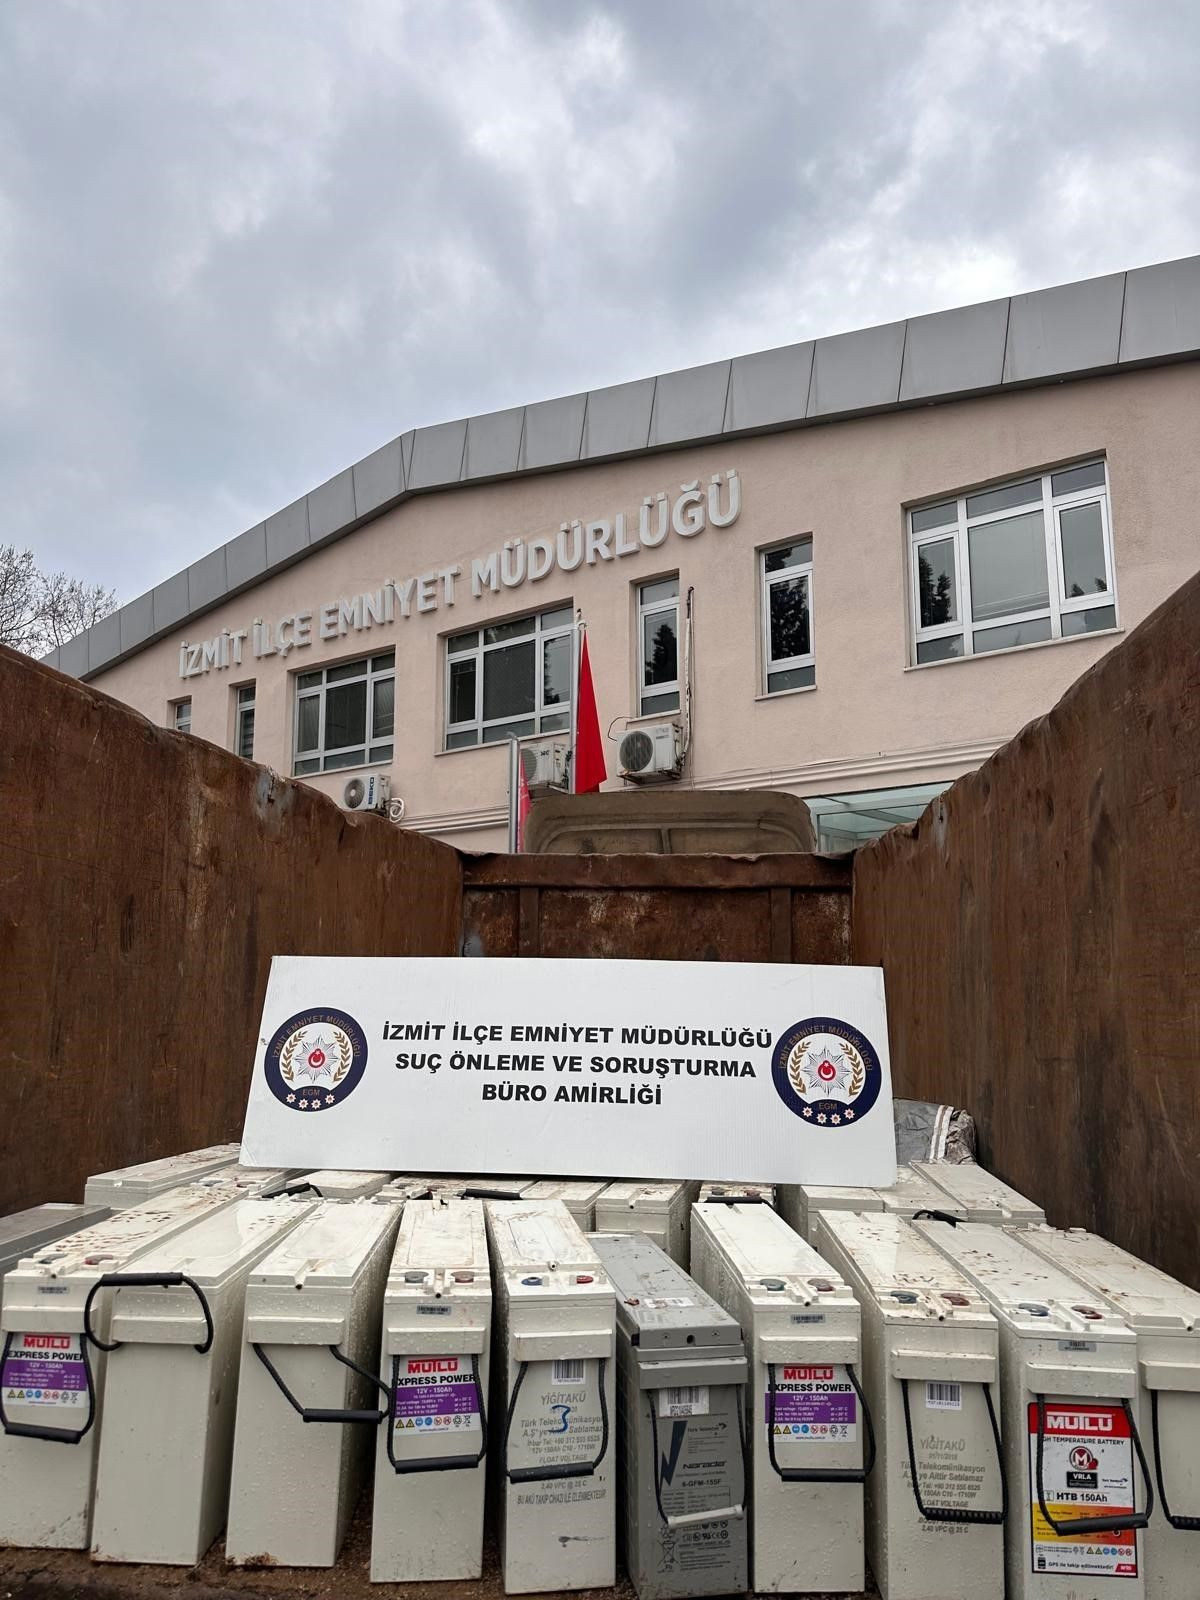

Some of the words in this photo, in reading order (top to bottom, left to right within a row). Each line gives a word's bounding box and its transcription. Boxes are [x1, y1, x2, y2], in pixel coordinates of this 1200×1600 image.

[180, 628, 246, 679] İZMİT
[252, 609, 312, 657] İLÇE
[320, 565, 462, 640] EMNİYET
[471, 469, 742, 598] MÜDÜRLÜĞÜ
[382, 1021, 446, 1040] İZMİT
[452, 1021, 503, 1046] İLÇE
[510, 1022, 614, 1044] EMNİYET
[621, 1025, 772, 1048] MÜDÜRLÜĞÜ
[395, 1053, 442, 1074] SUÇ
[450, 1051, 545, 1072] ÖNLEME
[553, 1056, 582, 1072] VE
[590, 1056, 757, 1080] SORUŞTURMA
[482, 1081, 547, 1102] BÜRO
[554, 1083, 662, 1105] AMİRLİĞİ
[24, 1335, 70, 1349] MUTLU
[408, 1358, 458, 1374] MUTLU
[784, 1366, 833, 1380] MUTLU
[398, 1376, 437, 1386] XPRESS
[547, 1404, 571, 1432] 3
[1047, 1412, 1112, 1431] MUTLU
[1056, 1492, 1078, 1501] HTB
[1080, 1493, 1107, 1502] 150Ah
